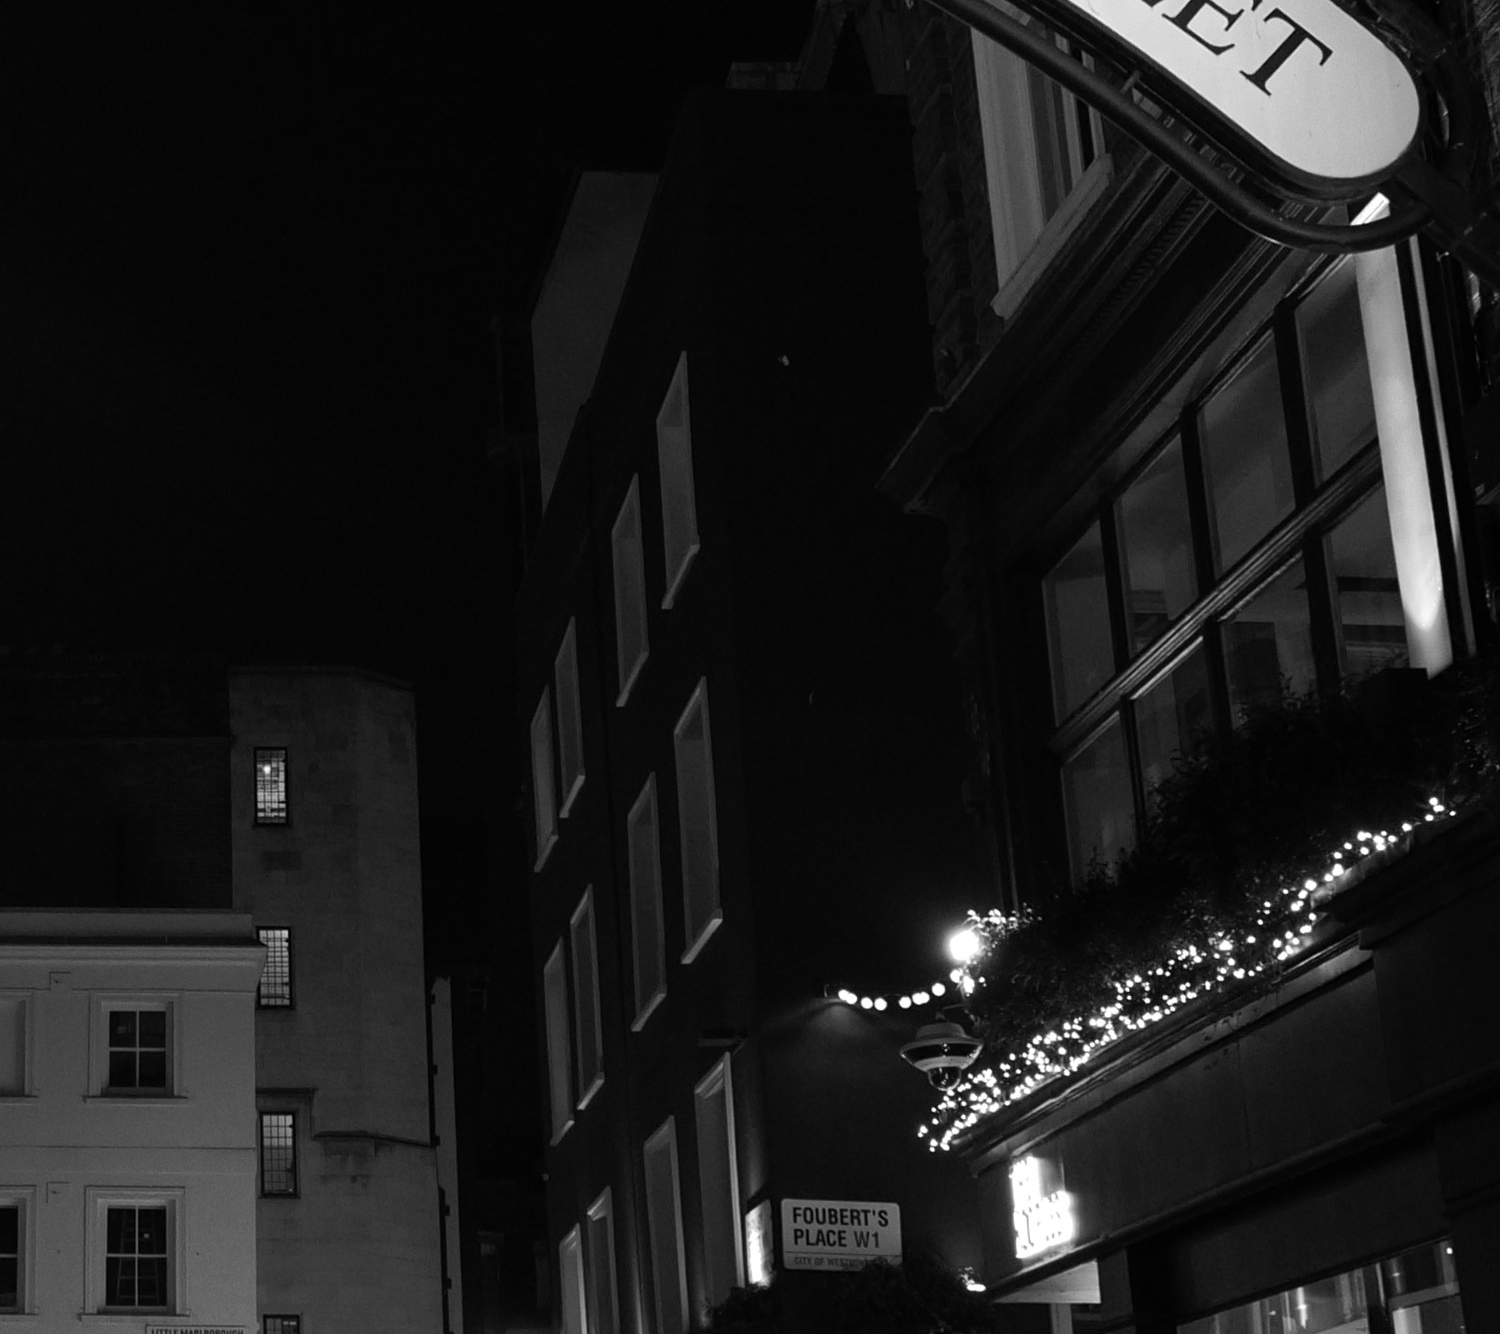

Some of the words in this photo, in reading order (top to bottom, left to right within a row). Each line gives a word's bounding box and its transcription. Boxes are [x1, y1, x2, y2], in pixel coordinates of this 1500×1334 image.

[792, 1207, 888, 1227] FOUBERT'S
[794, 1228, 847, 1248] PLACE
[854, 1230, 880, 1249] W1
[794, 1256, 812, 1266] CITY
[814, 1257, 825, 1267] OF
